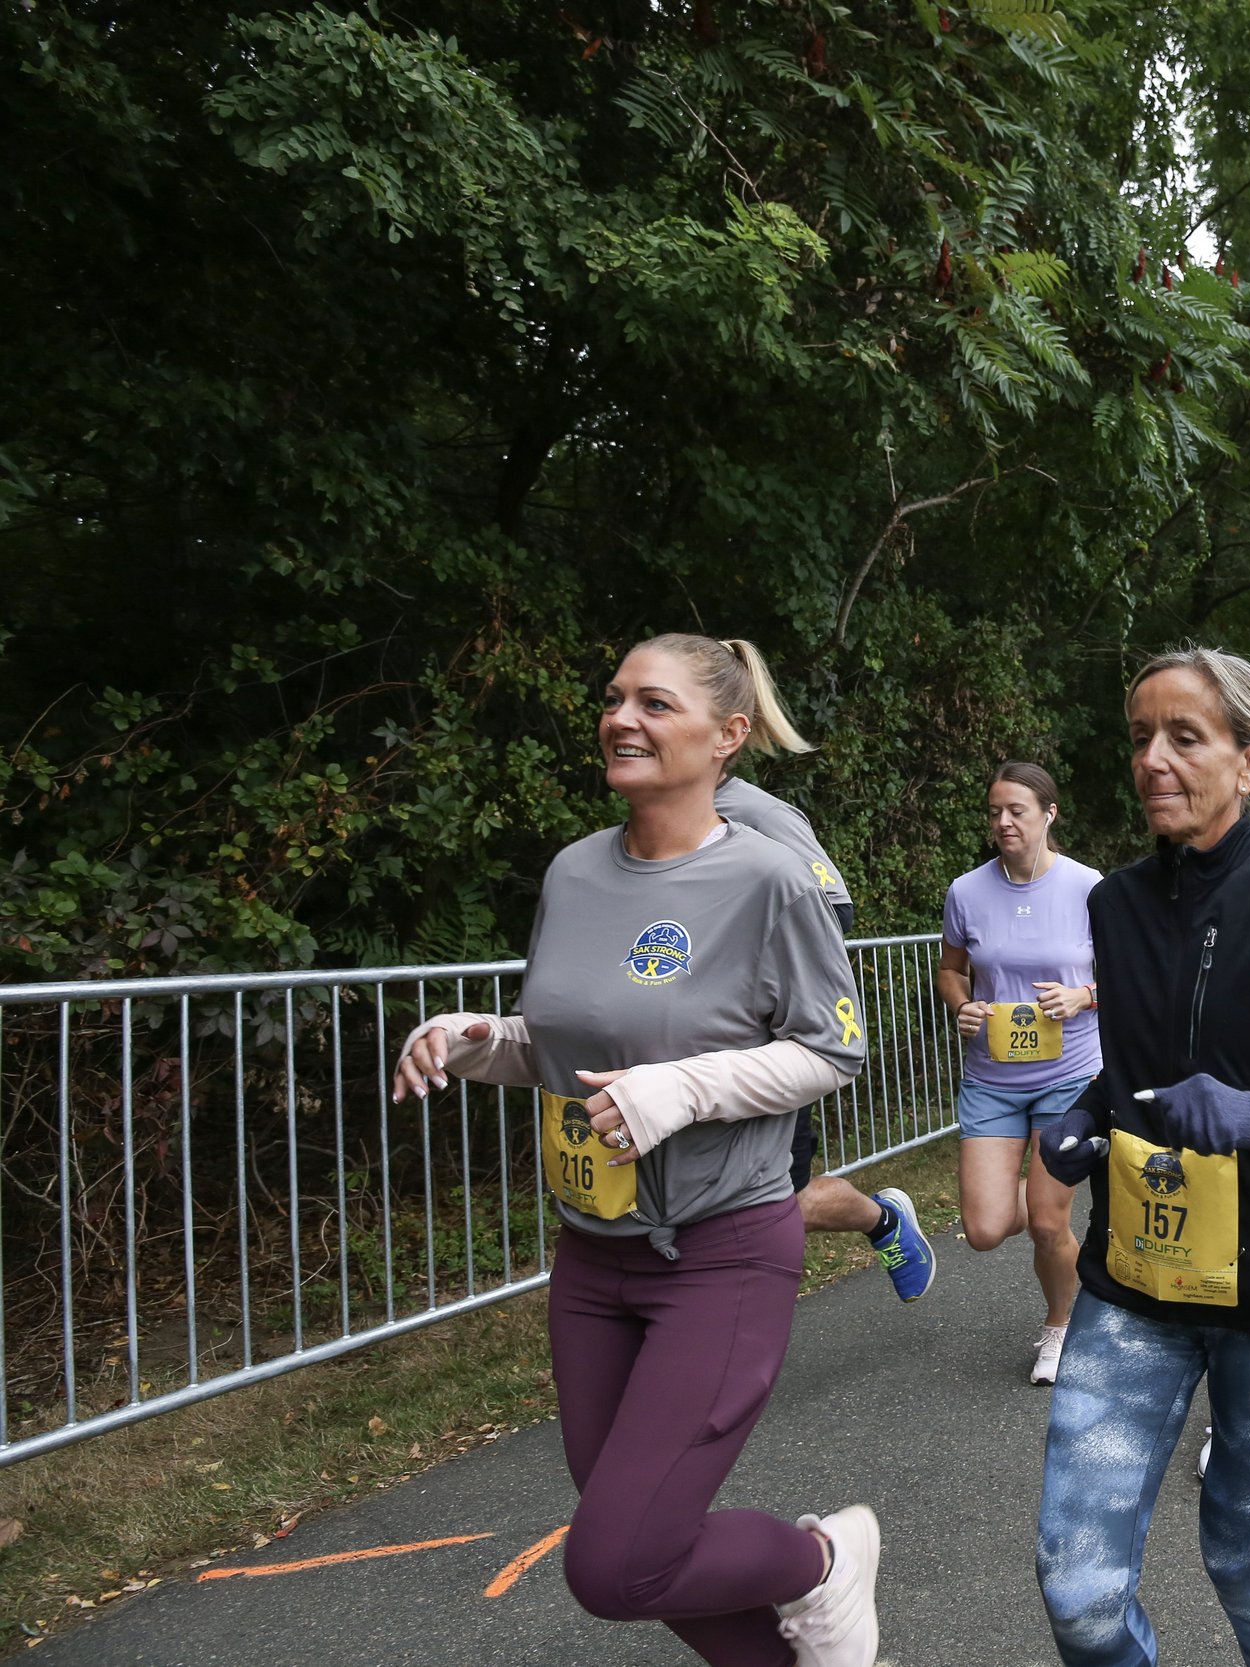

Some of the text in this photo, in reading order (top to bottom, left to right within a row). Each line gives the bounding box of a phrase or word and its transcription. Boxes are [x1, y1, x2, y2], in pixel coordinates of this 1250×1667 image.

[633, 945, 687, 961] SAK STRONG
[1010, 1031, 1038, 1049] 229
[560, 1151, 594, 1191] 216
[1142, 1200, 1188, 1242] 157
[1135, 1238, 1192, 1257] Di DUFFY
